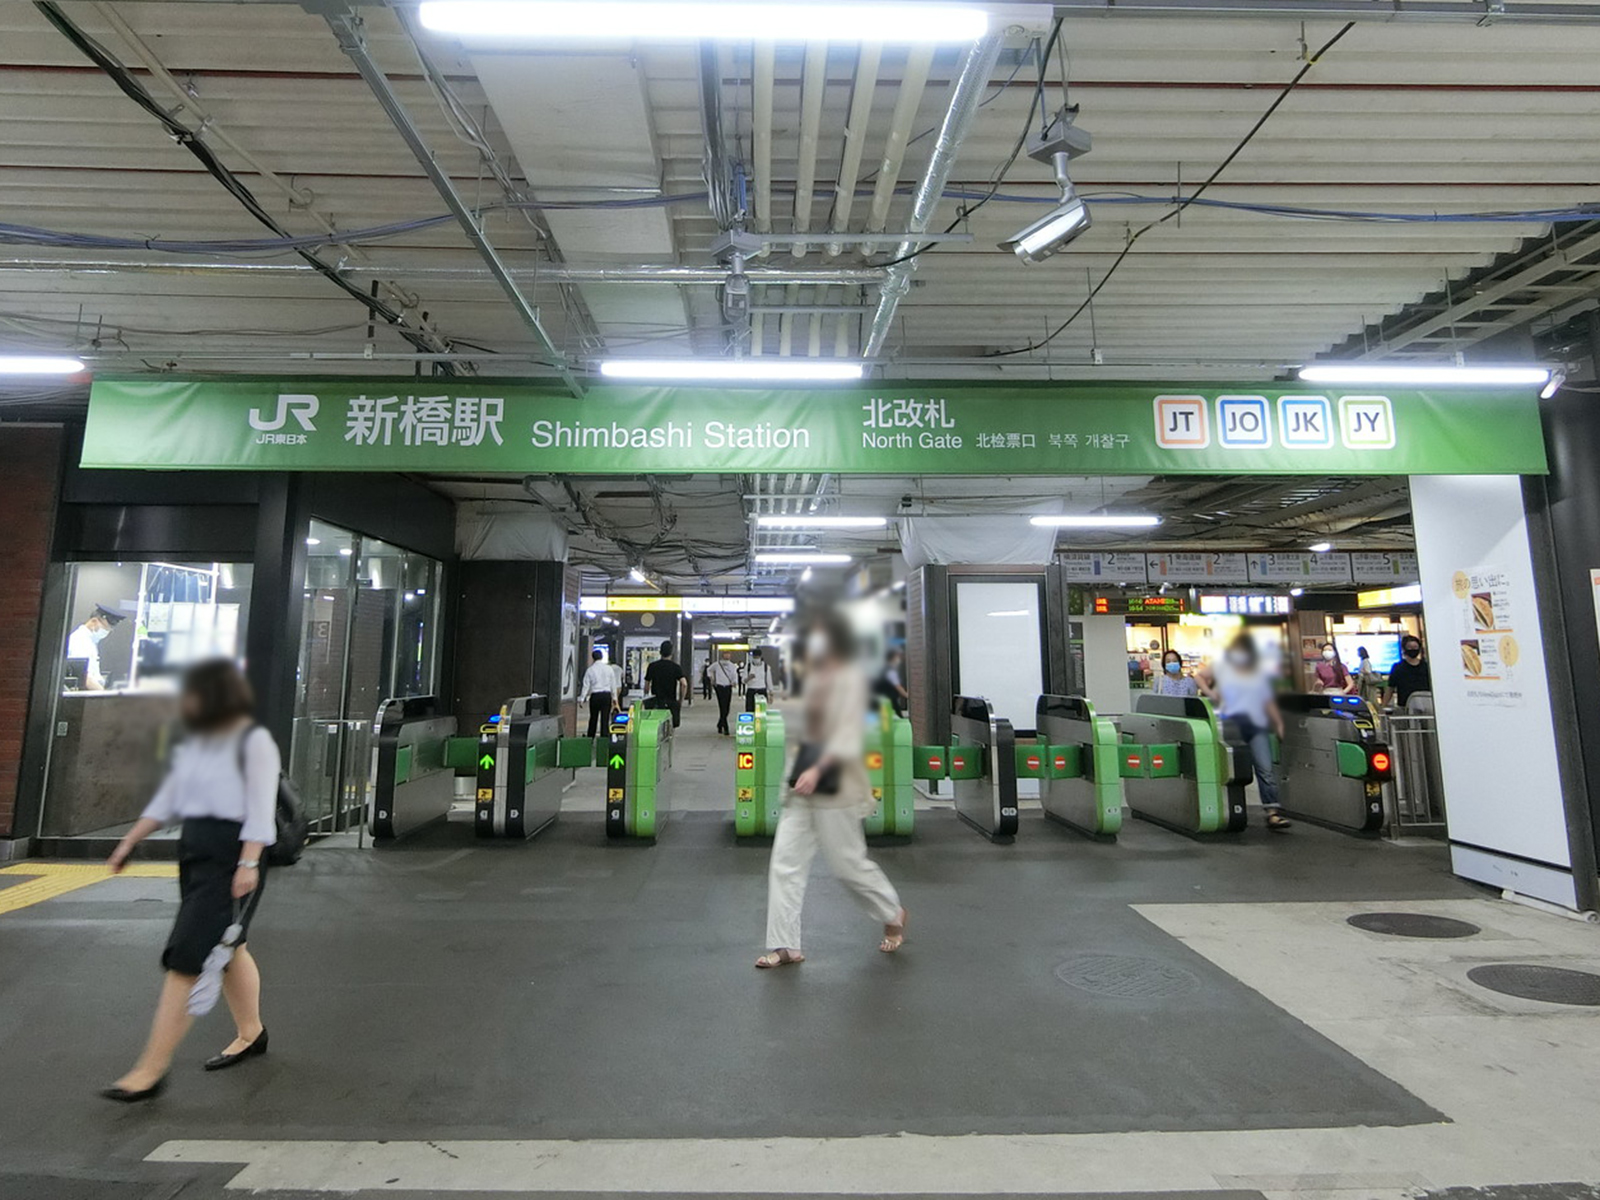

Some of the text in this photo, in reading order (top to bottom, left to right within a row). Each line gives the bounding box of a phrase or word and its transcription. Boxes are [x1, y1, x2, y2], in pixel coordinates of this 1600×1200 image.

[249, 394, 320, 432] JR
[344, 394, 505, 447] 新橋駅
[862, 398, 955, 429] 北改札
[1169, 411, 1194, 432] JT
[1227, 411, 1260, 432] JO
[1291, 411, 1320, 432] JK
[1353, 411, 1380, 433] JY
[256, 433, 308, 445] JR東日本
[531, 420, 810, 449] Shimbashi Station
[862, 432, 962, 449] North Gate
[976, 432, 1036, 449] 北检票口
[1048, 433, 1131, 449] 북쪽 개찰구
[1269, 553, 1275, 565] 3
[1310, 553, 1318, 565] 4
[1383, 553, 1391, 565] 5
[737, 725, 755, 736] IC
[738, 754, 753, 768] IC
